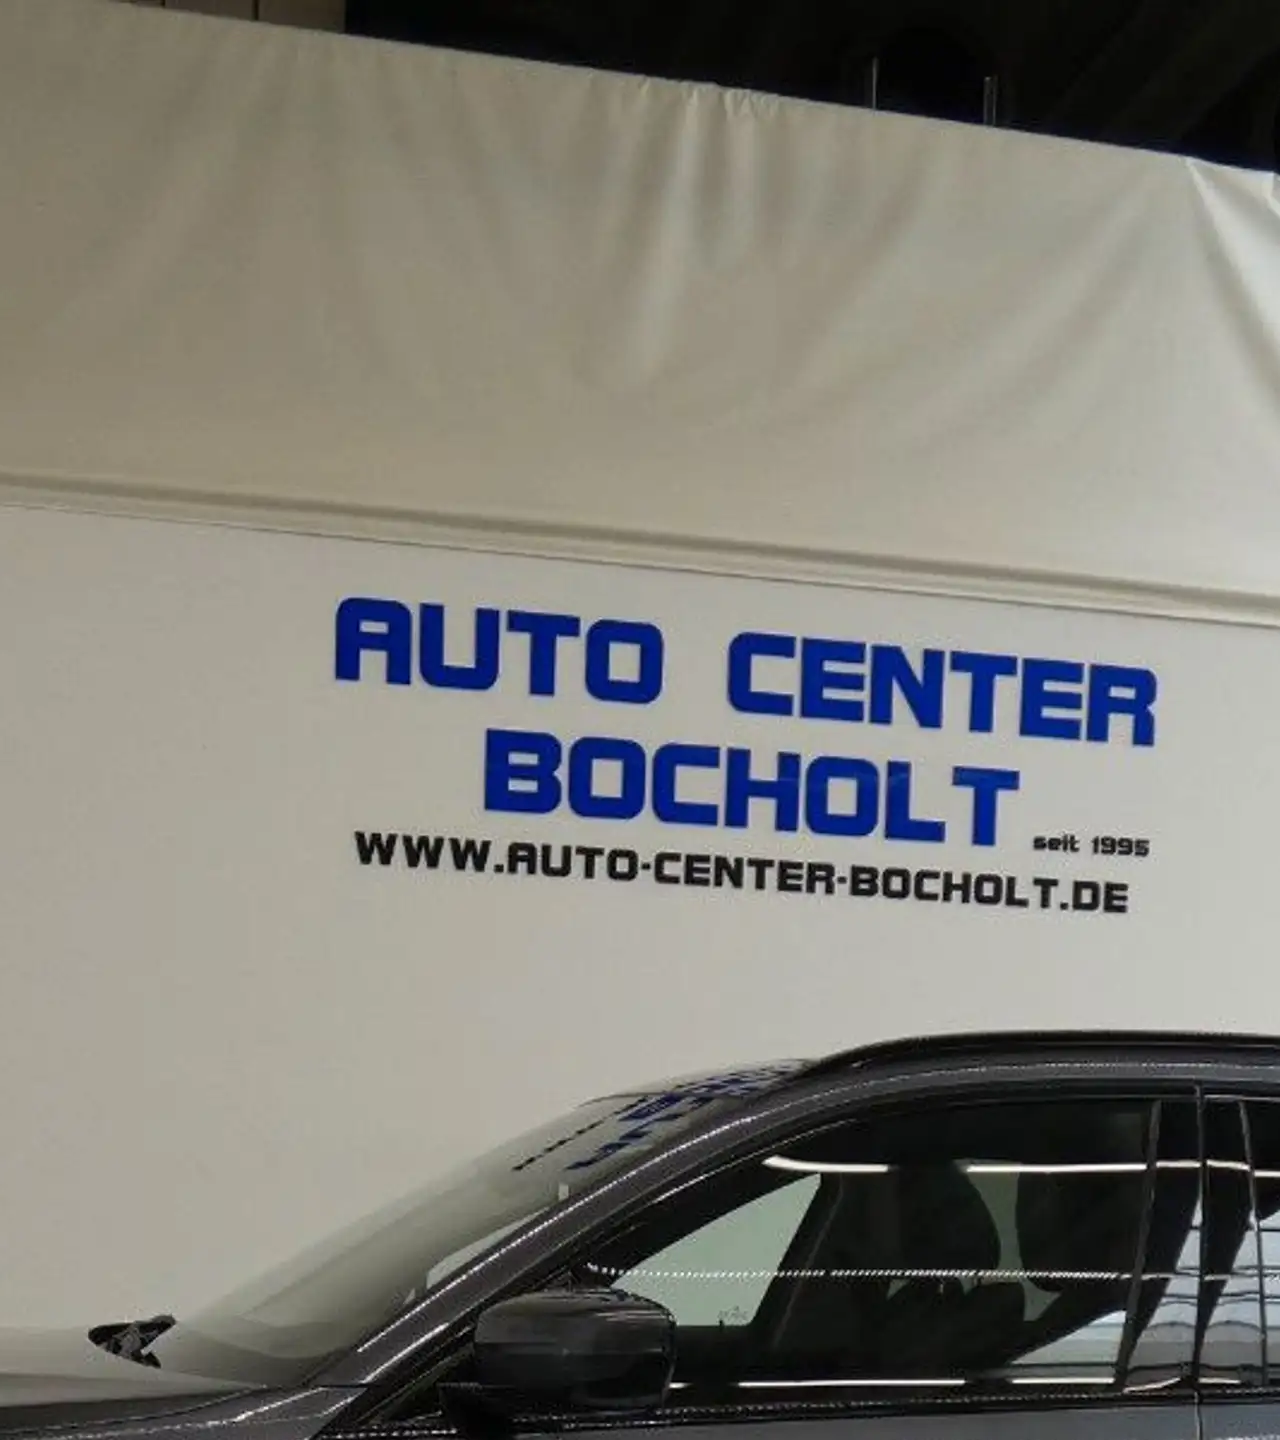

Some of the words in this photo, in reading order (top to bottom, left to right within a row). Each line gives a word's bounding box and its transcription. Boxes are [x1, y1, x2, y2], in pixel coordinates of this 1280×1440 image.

[335, 598, 664, 705] AUTO
[727, 631, 1158, 748] CENTER
[484, 728, 1022, 848] BOCHOLT
[354, 830, 1130, 914] WWW.AUTO-CENTER-BOCHOLT.DE
[1033, 834, 1080, 853] seit
[1091, 836, 1151, 858] 1995
